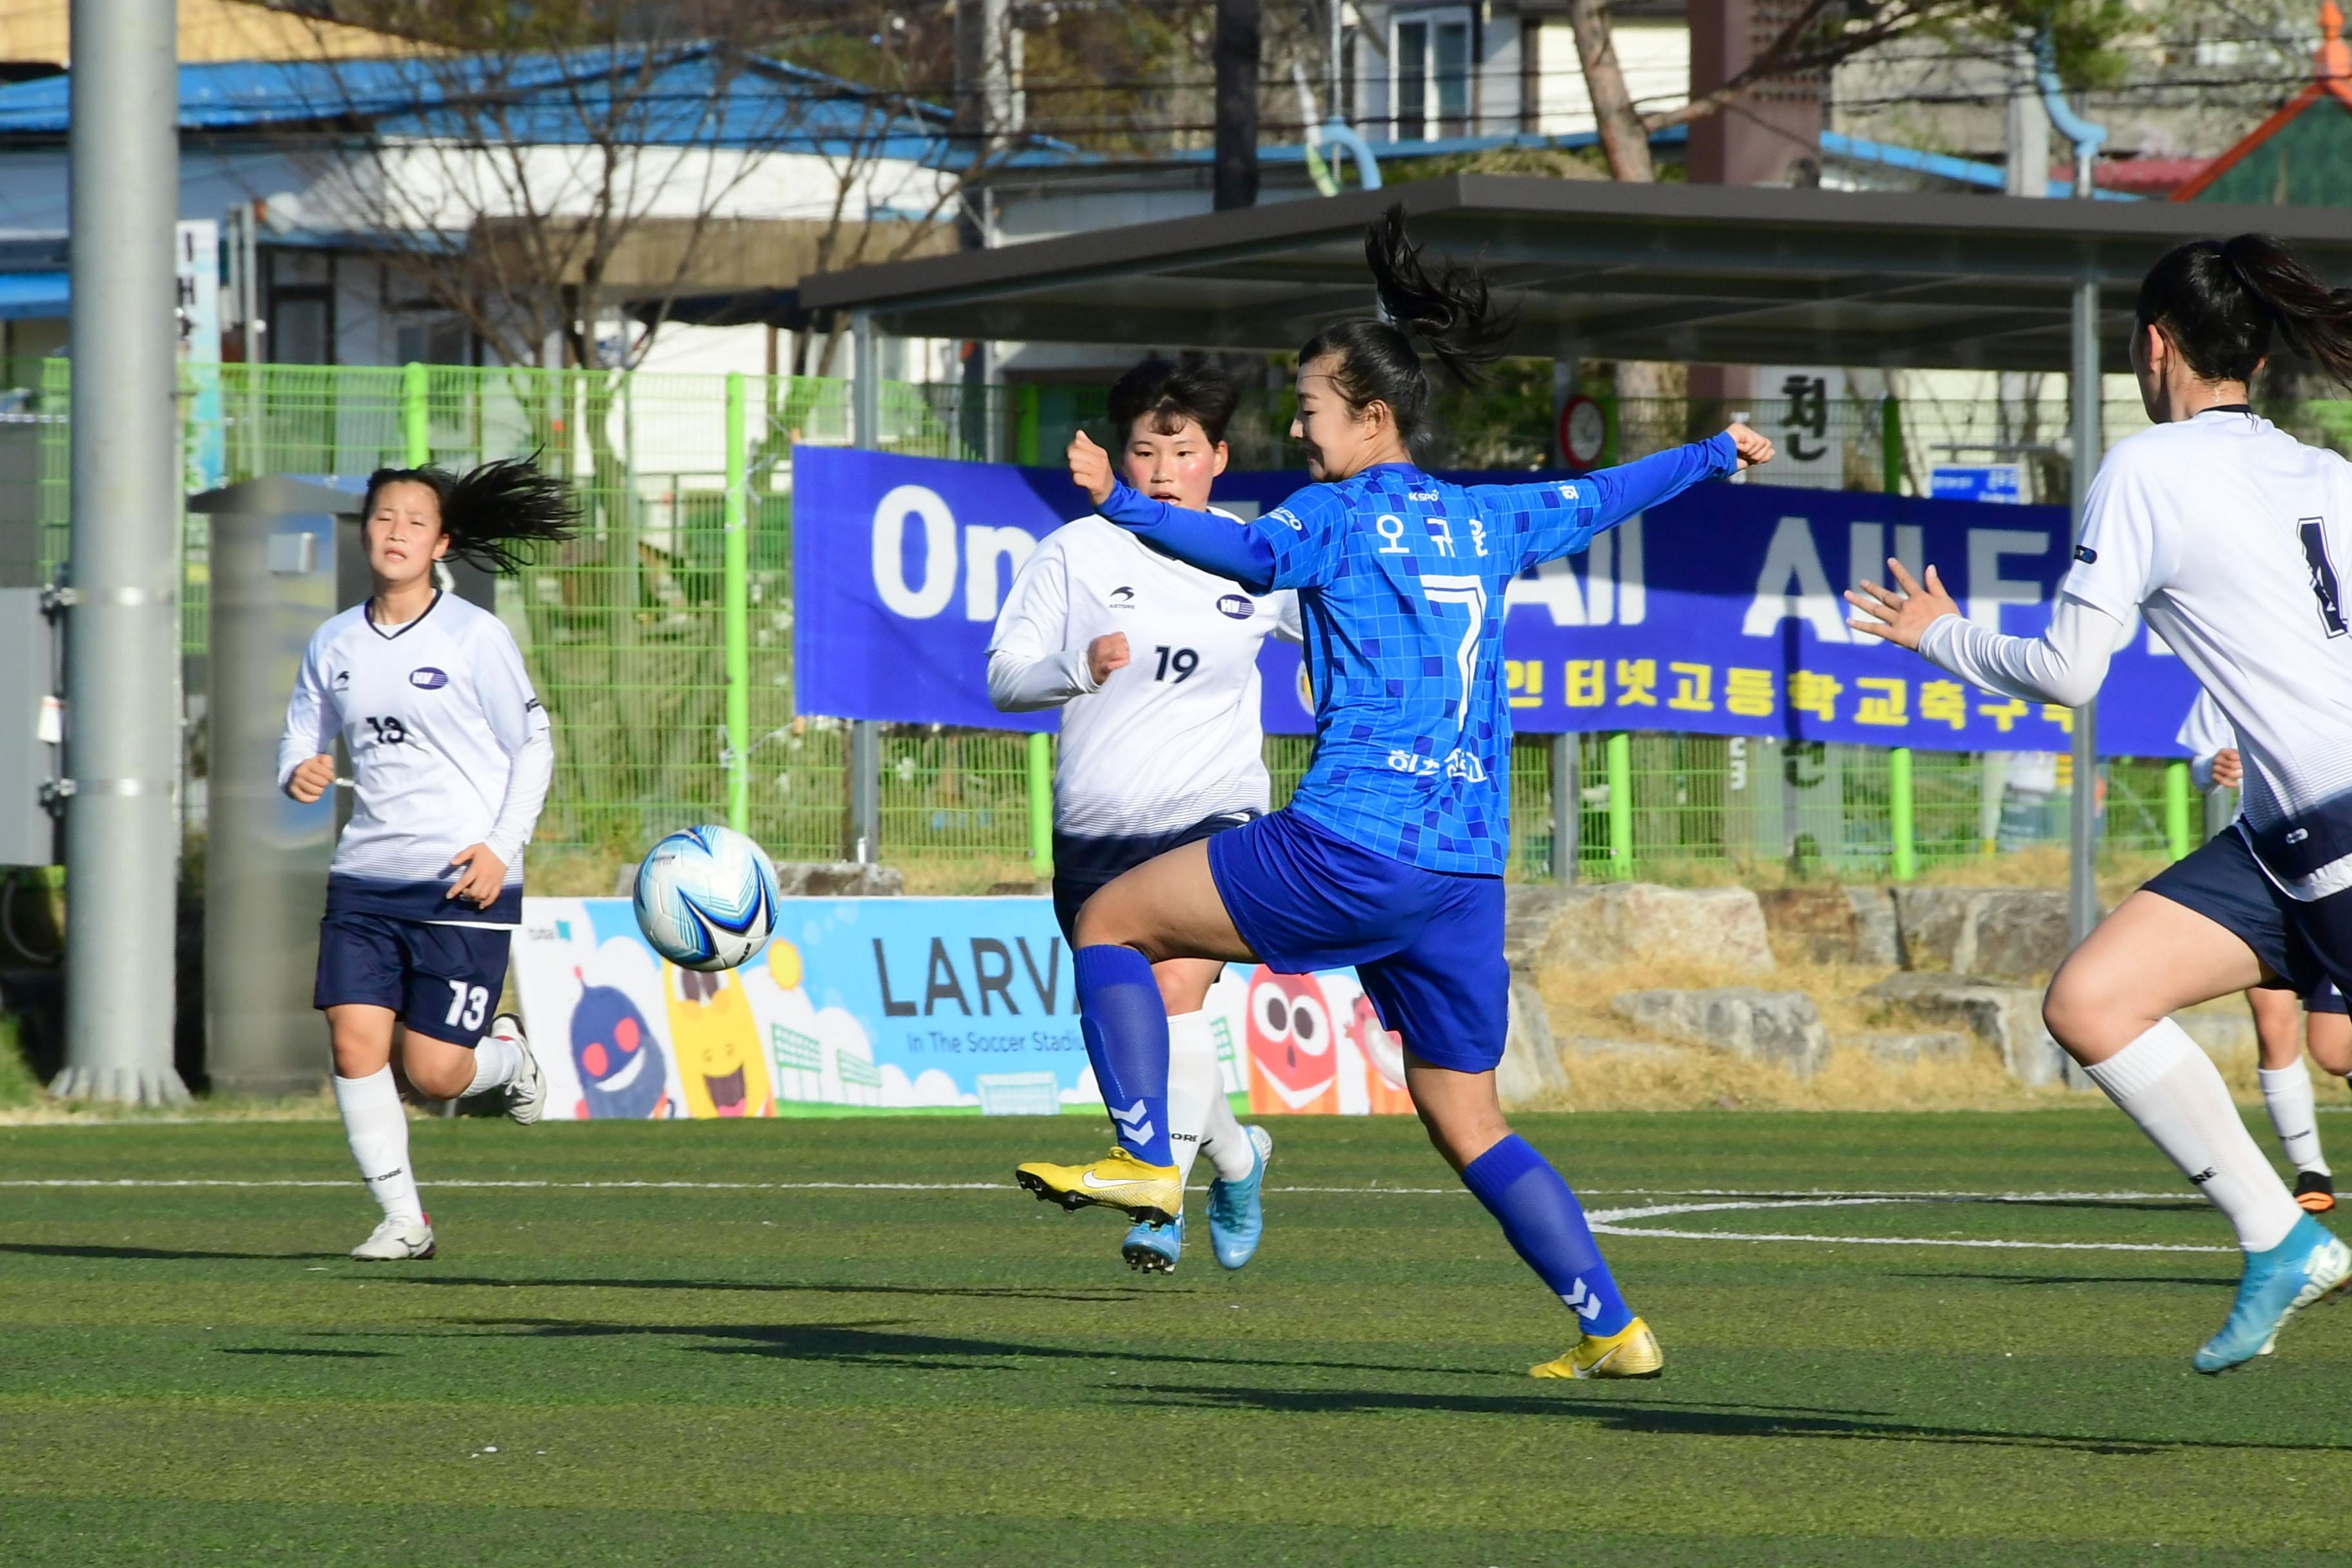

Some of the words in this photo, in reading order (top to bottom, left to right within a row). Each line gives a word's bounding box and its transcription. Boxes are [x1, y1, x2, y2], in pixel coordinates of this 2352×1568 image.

[1408, 489, 1439, 502] KSPO
[872, 484, 1037, 622] On
[1743, 516, 1924, 647] All
[1154, 645, 1200, 684] 19
[1419, 574, 1487, 732] 7
[366, 716, 405, 744] 13
[872, 937, 1081, 1017] LARV
[445, 979, 489, 1032] 13
[907, 1033, 924, 1052] In
[929, 1032, 961, 1053] The
[968, 1032, 1025, 1052] Soccer
